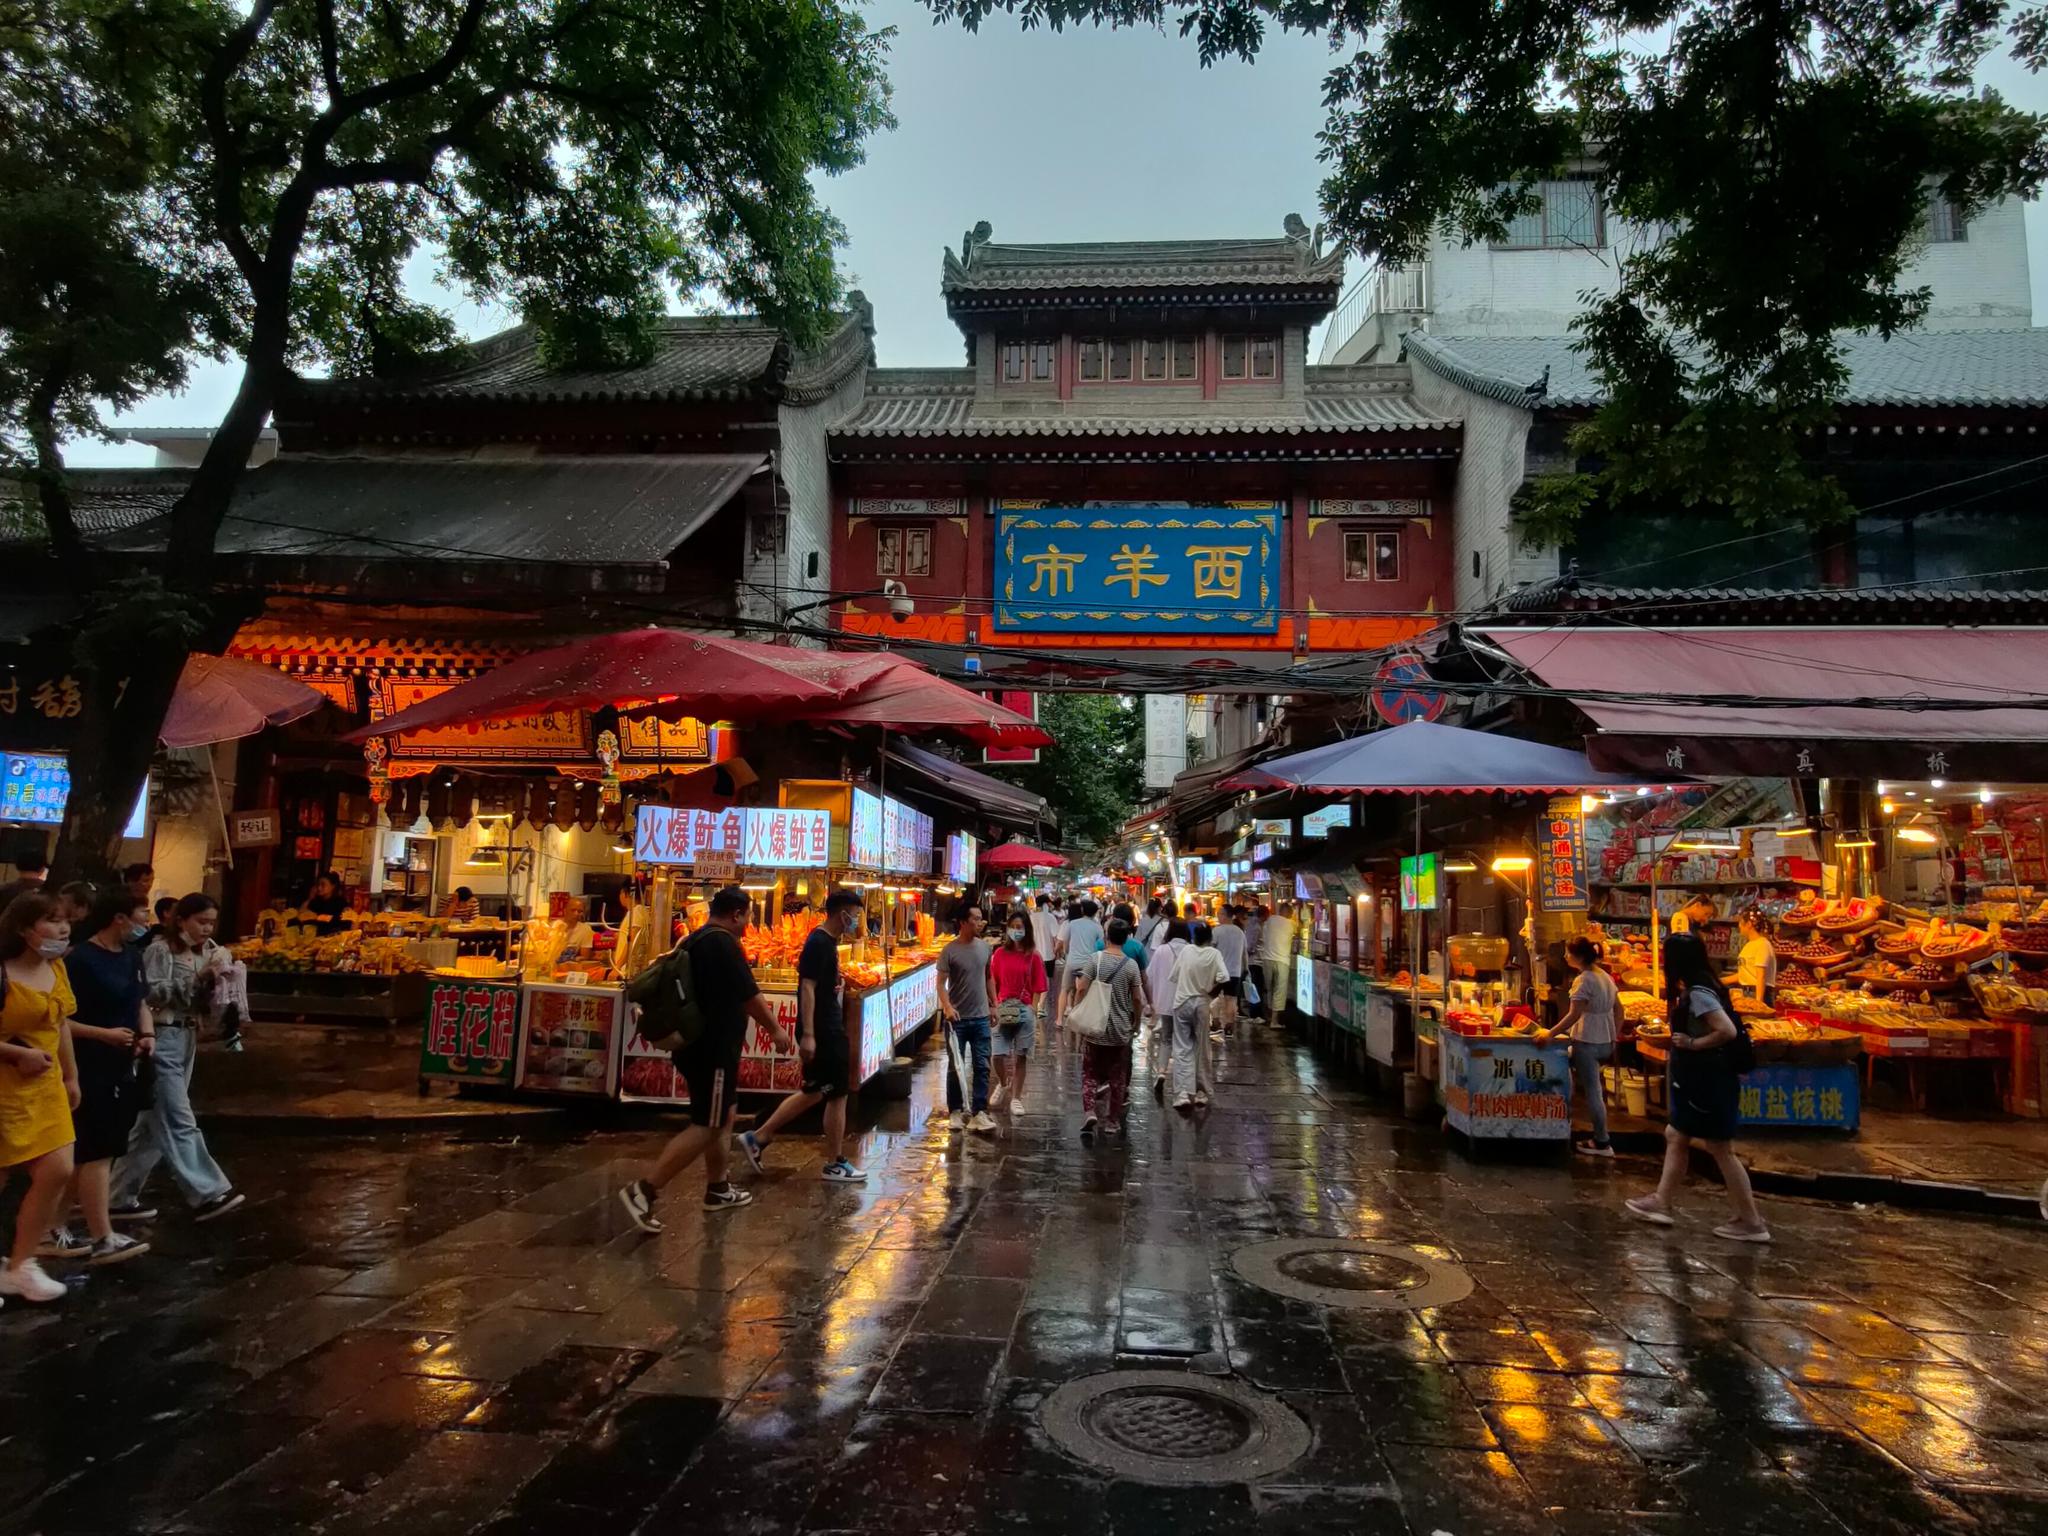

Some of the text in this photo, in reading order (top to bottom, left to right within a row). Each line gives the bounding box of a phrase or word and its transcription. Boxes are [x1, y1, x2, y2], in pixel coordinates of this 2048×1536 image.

[240, 819, 269, 834] 转让
[638, 808, 742, 859] 火爆鱿鱼
[748, 812, 826, 862] 火爆鱿鱼
[1550, 820, 1575, 897] 中通快递
[1493, 1058, 1545, 1080] 冰镇
